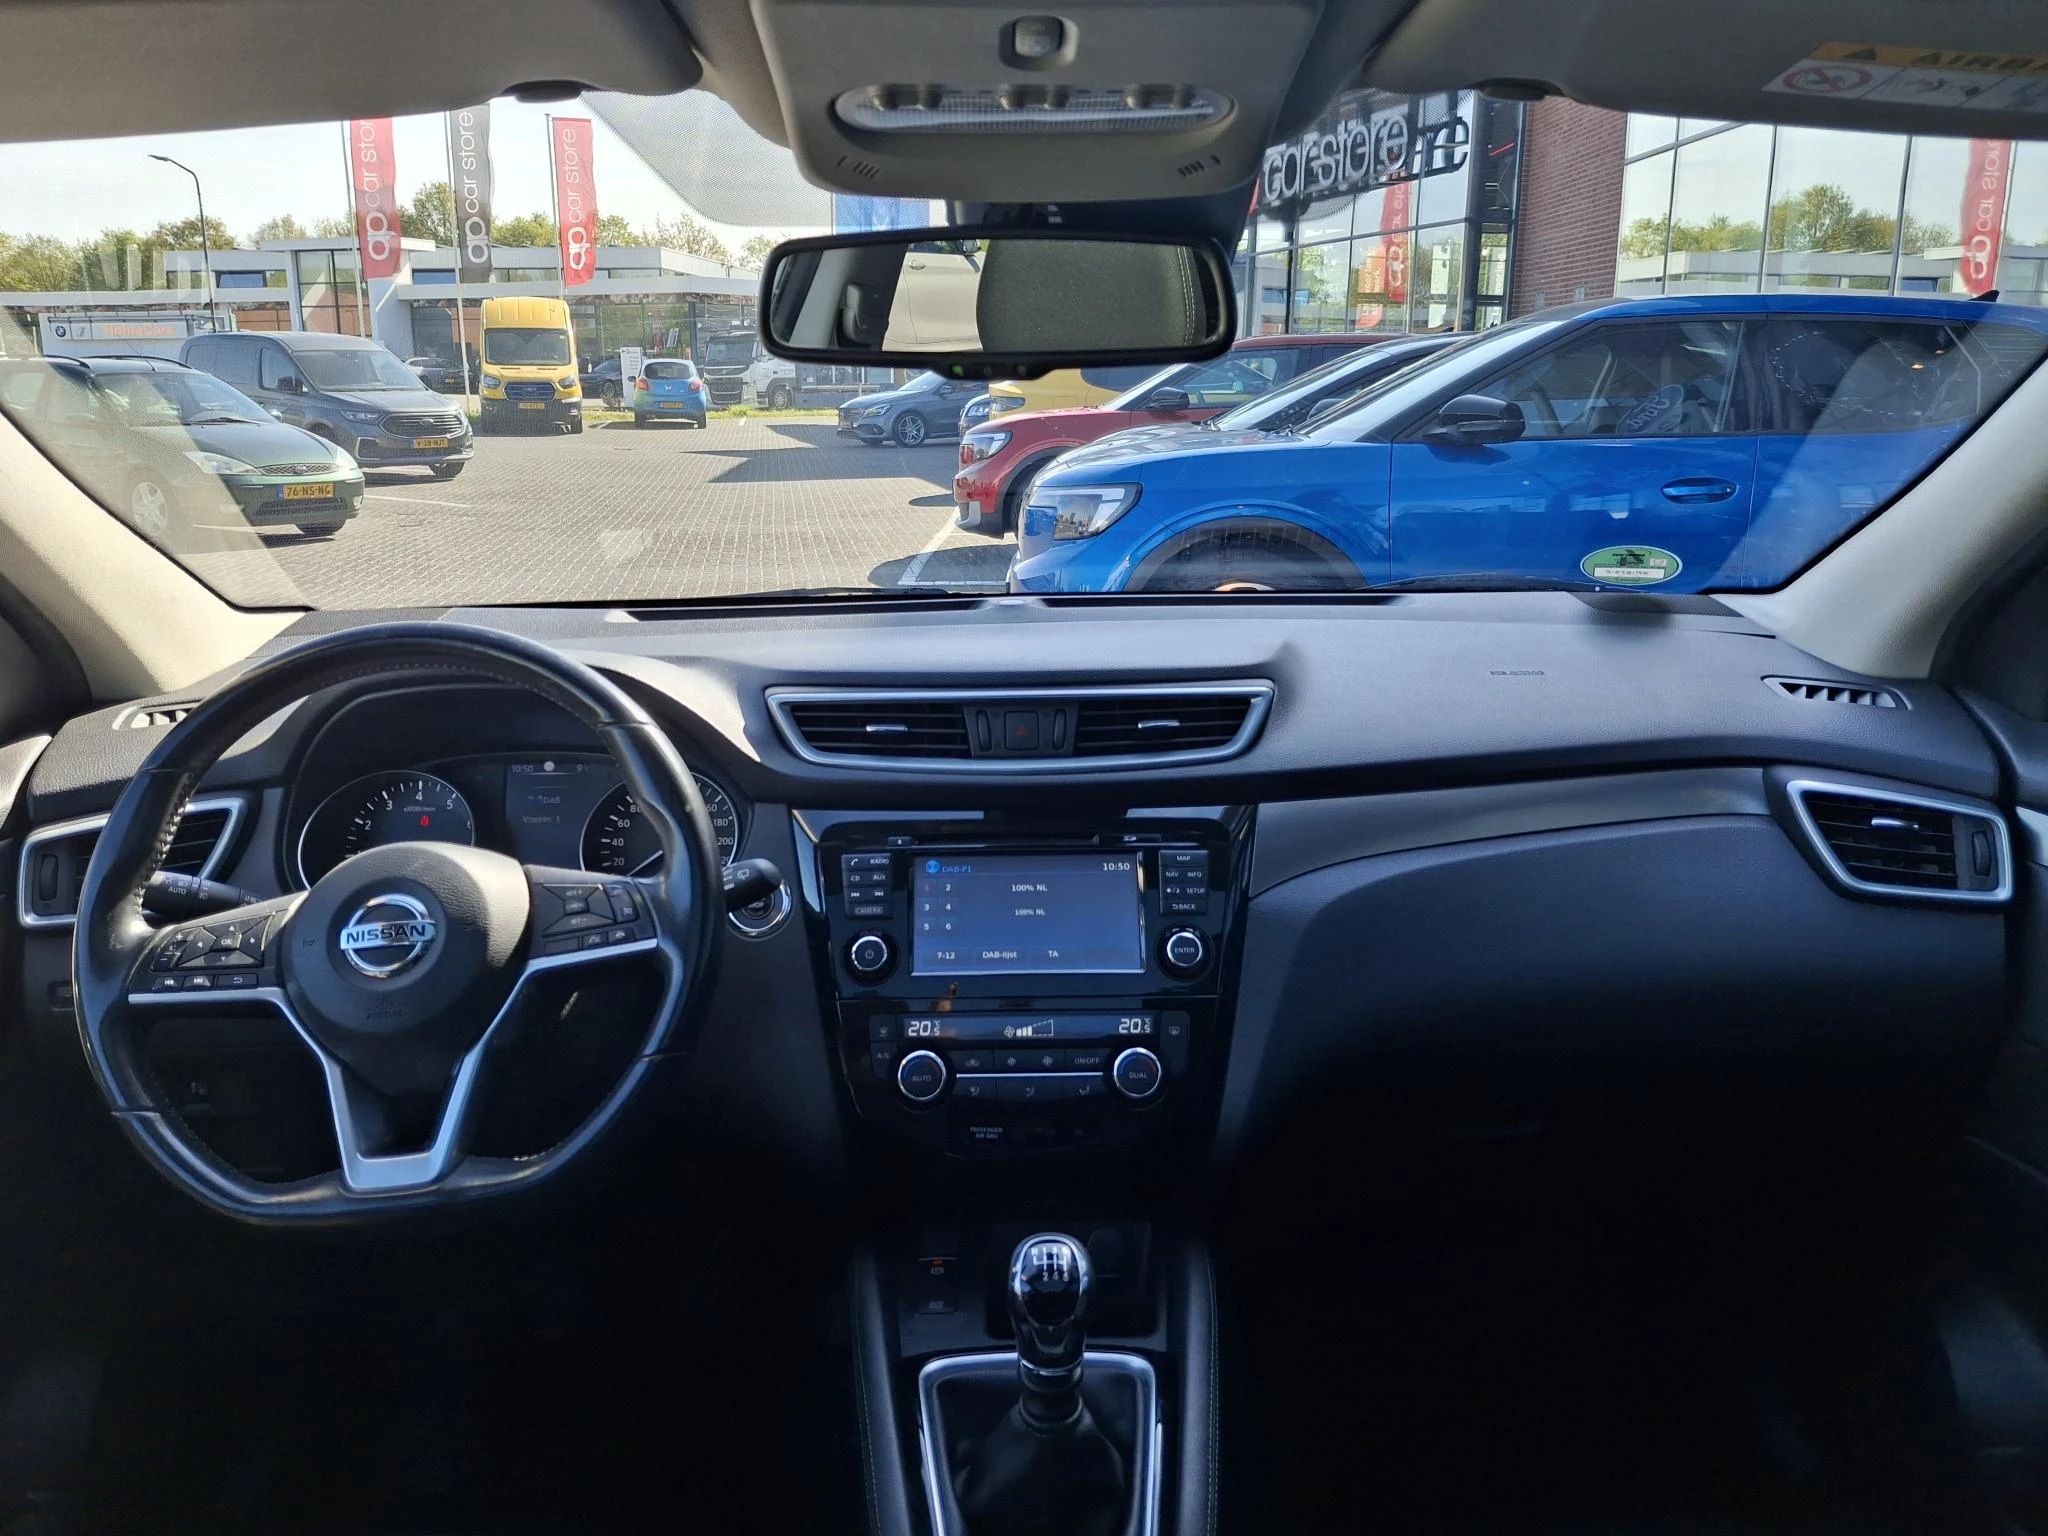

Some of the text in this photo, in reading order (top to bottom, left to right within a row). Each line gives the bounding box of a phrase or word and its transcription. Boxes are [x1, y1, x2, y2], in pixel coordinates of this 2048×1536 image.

[358, 119, 377, 164] stor
[459, 111, 476, 171] store
[561, 128, 579, 185] store
[361, 171, 379, 208] car
[463, 178, 479, 213] car
[566, 190, 584, 224] car
[286, 484, 331, 497] 76-NS-NG
[415, 791, 422, 801] 4
[385, 801, 393, 811] 3
[446, 800, 453, 810] 5
[364, 821, 371, 831] 2
[618, 819, 630, 828] 60
[713, 818, 729, 827] 180
[611, 838, 624, 847] 40
[717, 837, 734, 846] 200
[613, 857, 625, 866] 20
[1102, 862, 1130, 871] 10:50
[167, 887, 187, 895] AUTO
[945, 883, 951, 891] 2
[1012, 883, 1048, 892] 100% NL
[924, 903, 951, 911] 3 4
[924, 922, 952, 931] 5 6
[346, 924, 426, 945] NISSAN
[221, 938, 233, 946] OK
[937, 951, 956, 960] 7-12
[1048, 950, 1059, 958] TA
[912, 1074, 932, 1082] AUTO
[1128, 1071, 1148, 1079] DUAL
